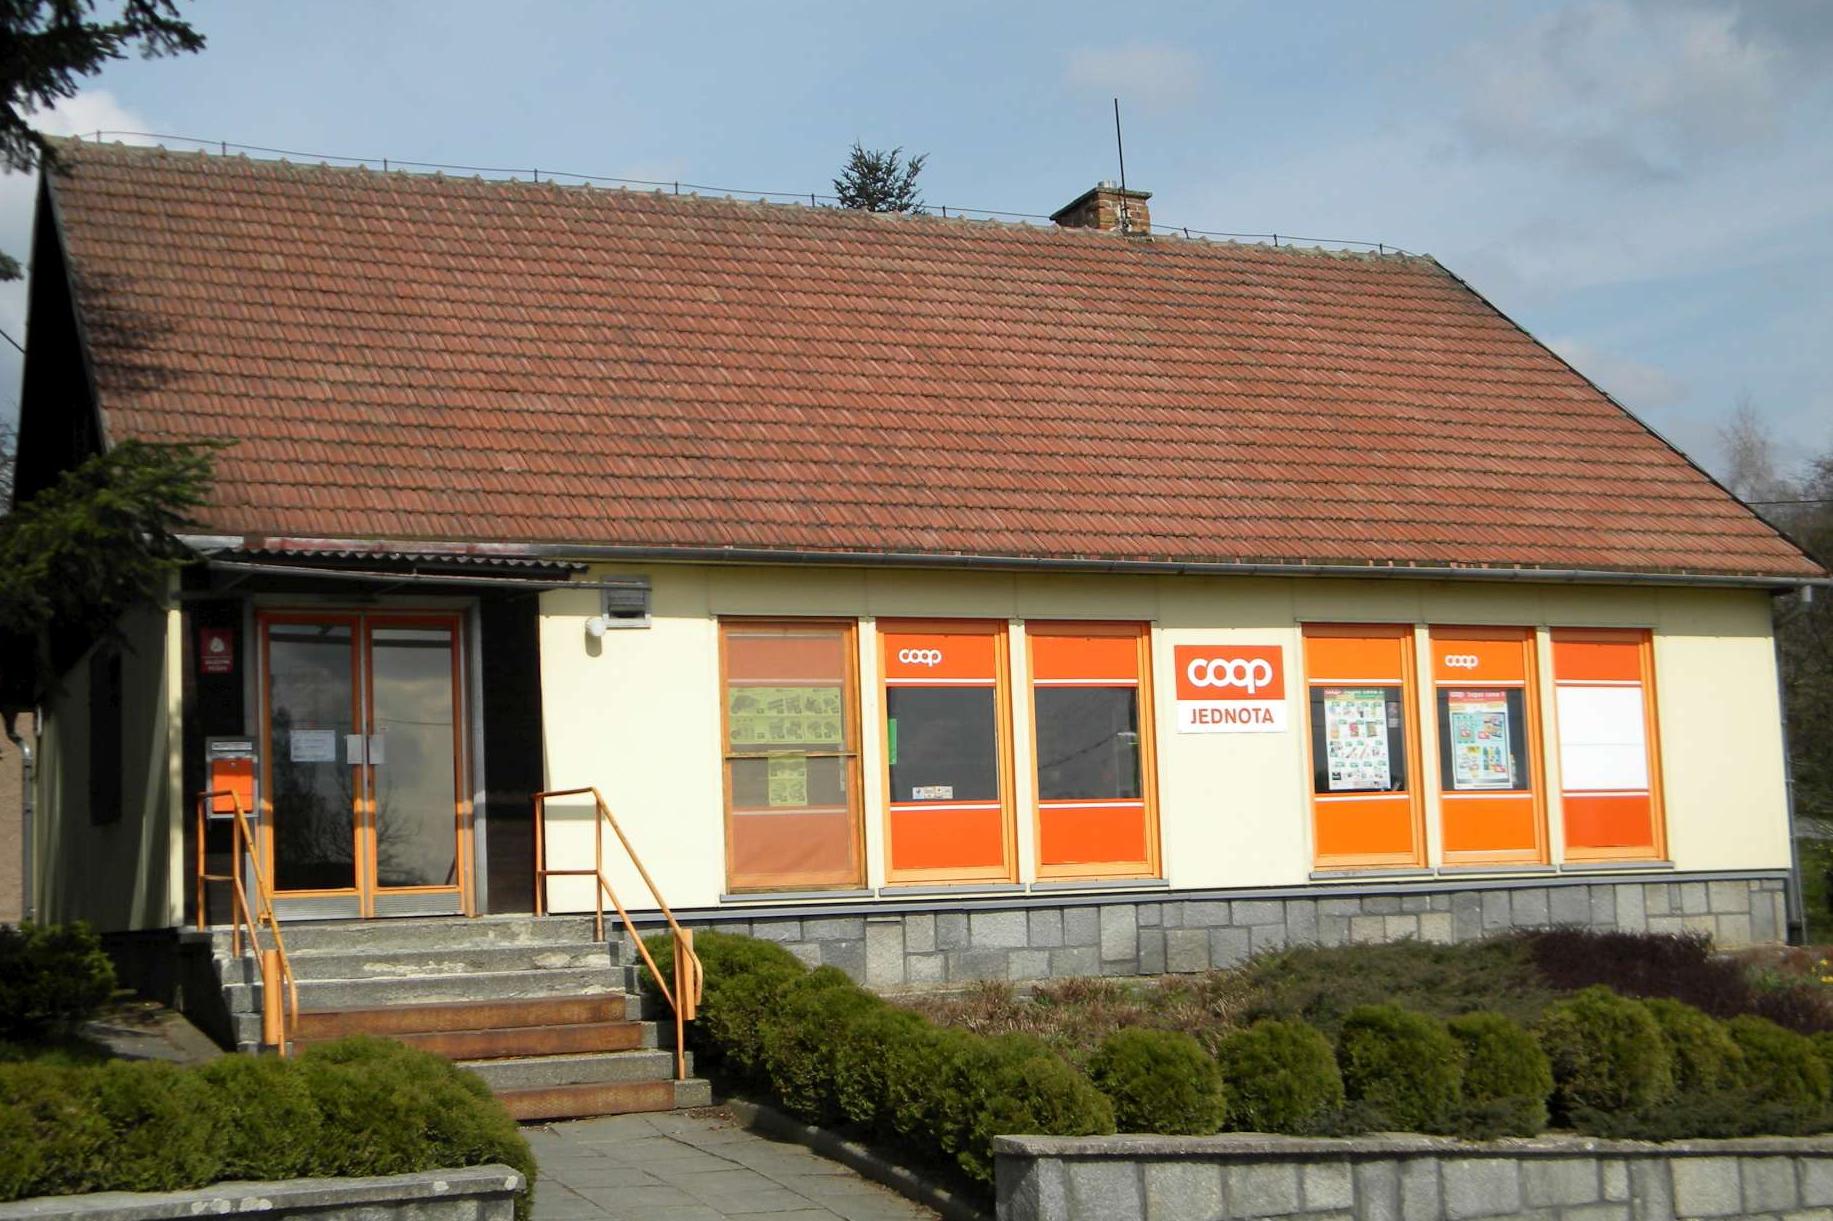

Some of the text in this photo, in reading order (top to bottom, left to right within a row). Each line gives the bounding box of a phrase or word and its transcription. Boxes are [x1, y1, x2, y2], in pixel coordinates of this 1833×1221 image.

[898, 648, 942, 667] coop
[1445, 655, 1479, 669] coop
[1187, 657, 1273, 694] coop
[1190, 707, 1275, 724] JEDNOTA
